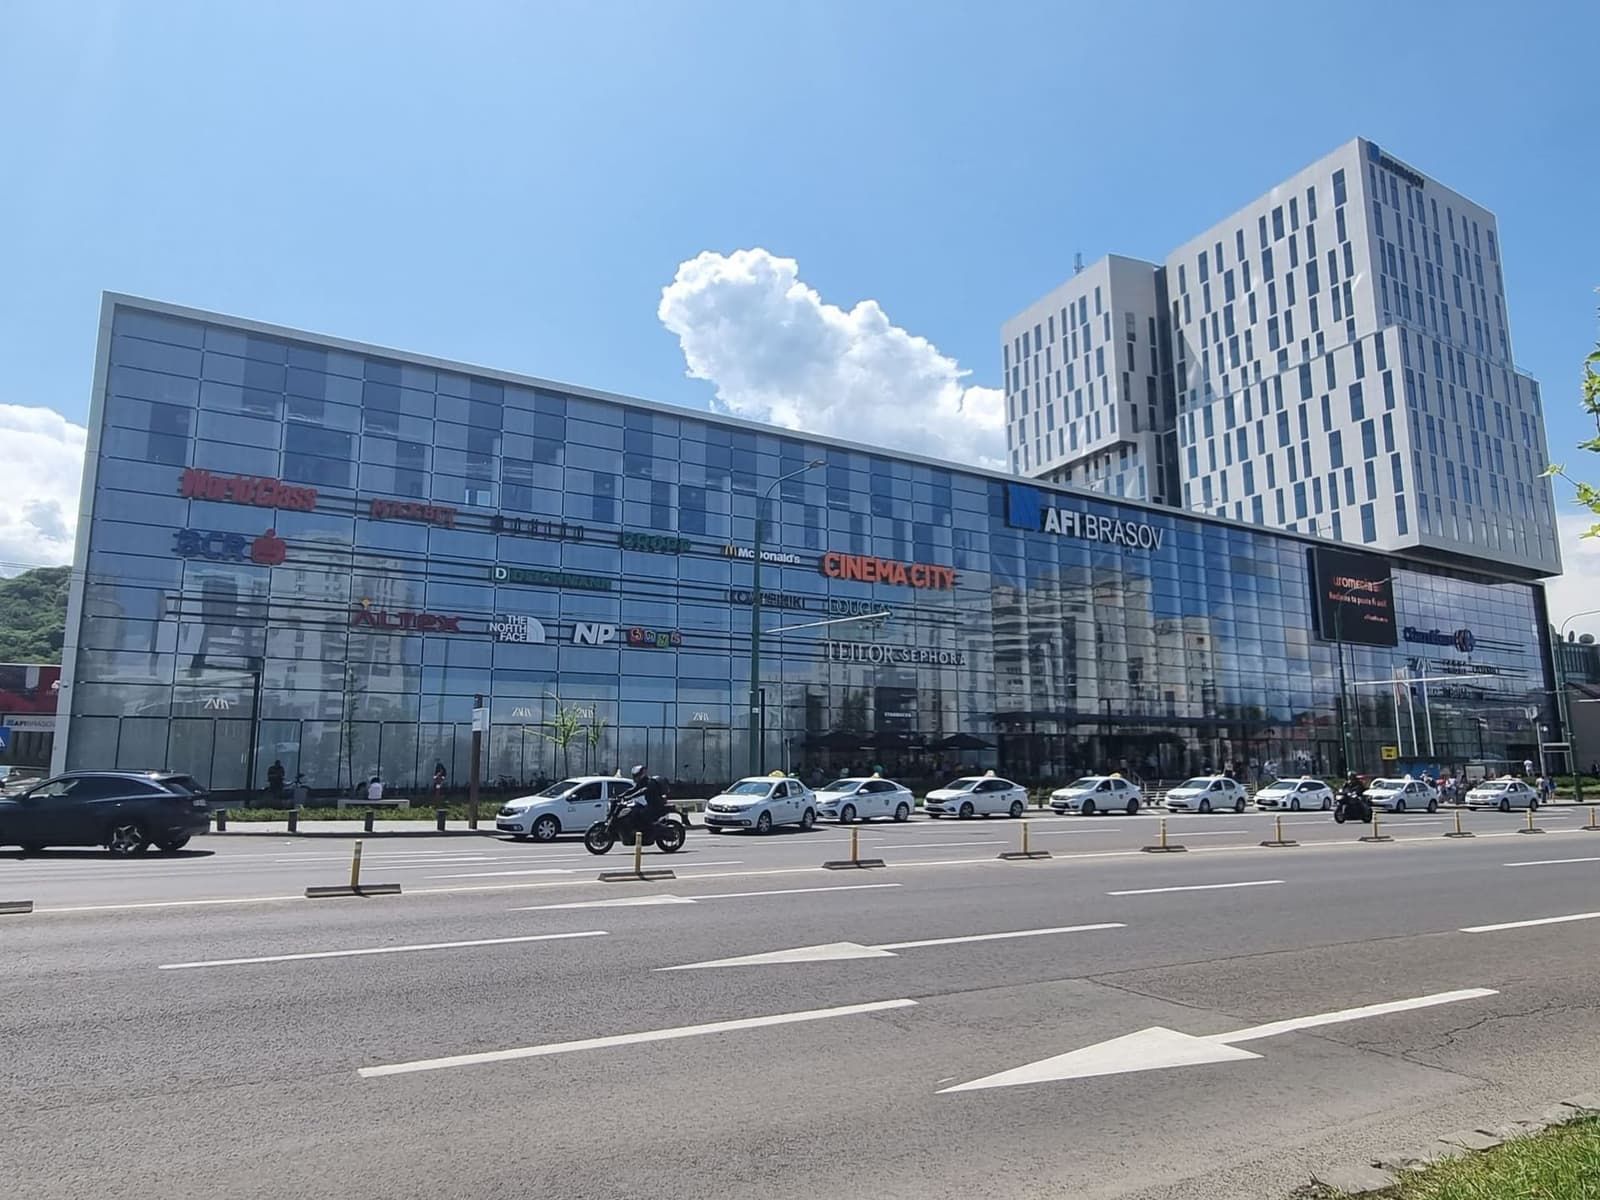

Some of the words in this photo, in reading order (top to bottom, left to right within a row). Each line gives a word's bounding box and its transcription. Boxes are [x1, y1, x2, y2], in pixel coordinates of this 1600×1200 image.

[1044, 507, 1081, 537] AFI
[823, 551, 909, 585] CINEMA
[911, 563, 956, 591] CITY
[489, 622, 528, 633] NORTH
[507, 615, 528, 625] THE
[500, 632, 528, 642] FACE
[573, 622, 616, 645] NP
[825, 641, 895, 664] TEILOR
[902, 650, 967, 665] SEPHORA
